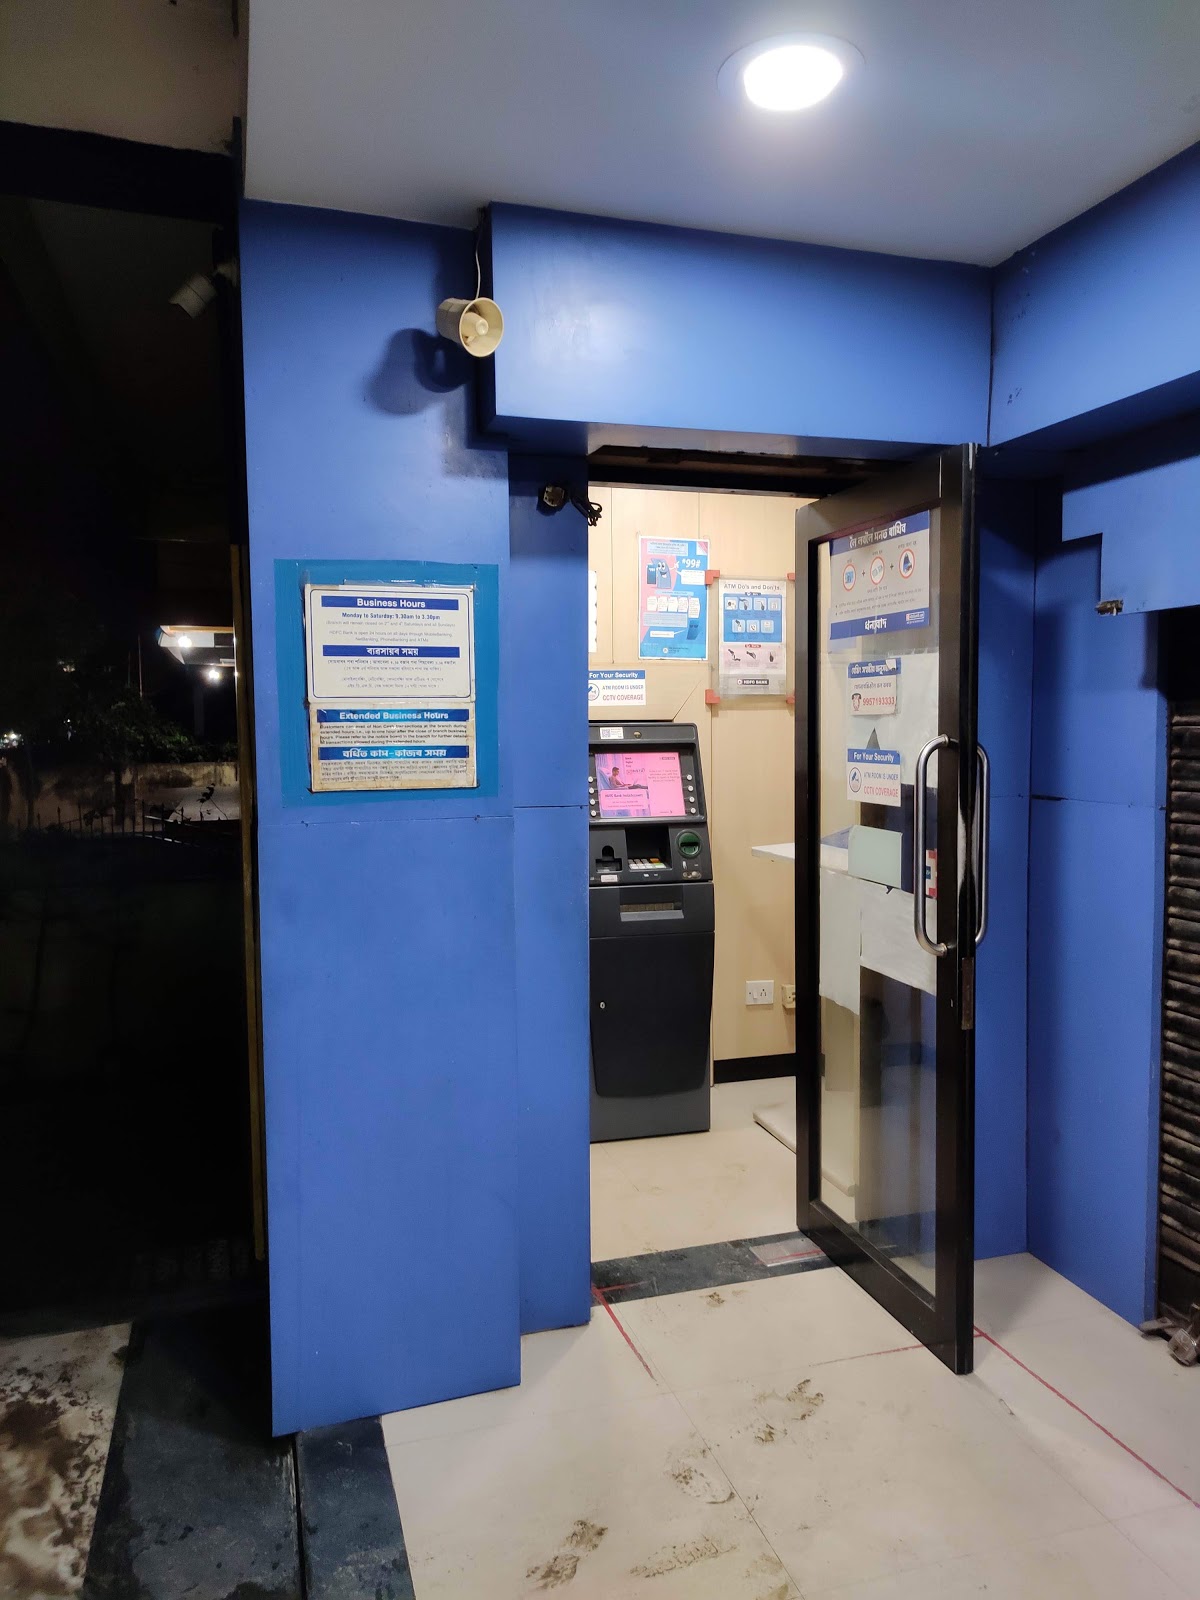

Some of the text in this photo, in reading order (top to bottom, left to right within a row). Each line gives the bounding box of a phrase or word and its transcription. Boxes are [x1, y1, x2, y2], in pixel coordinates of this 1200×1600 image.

[874, 529, 888, 541] মনত
[357, 598, 426, 608] Business Hours
[401, 648, 419, 657] সময়
[615, 671, 639, 679] Security
[340, 711, 449, 720] Extended Business Hours
[424, 749, 447, 757] সময়
[853, 752, 895, 763] For Your Security
[864, 786, 898, 798] CCTV COVERAGE
